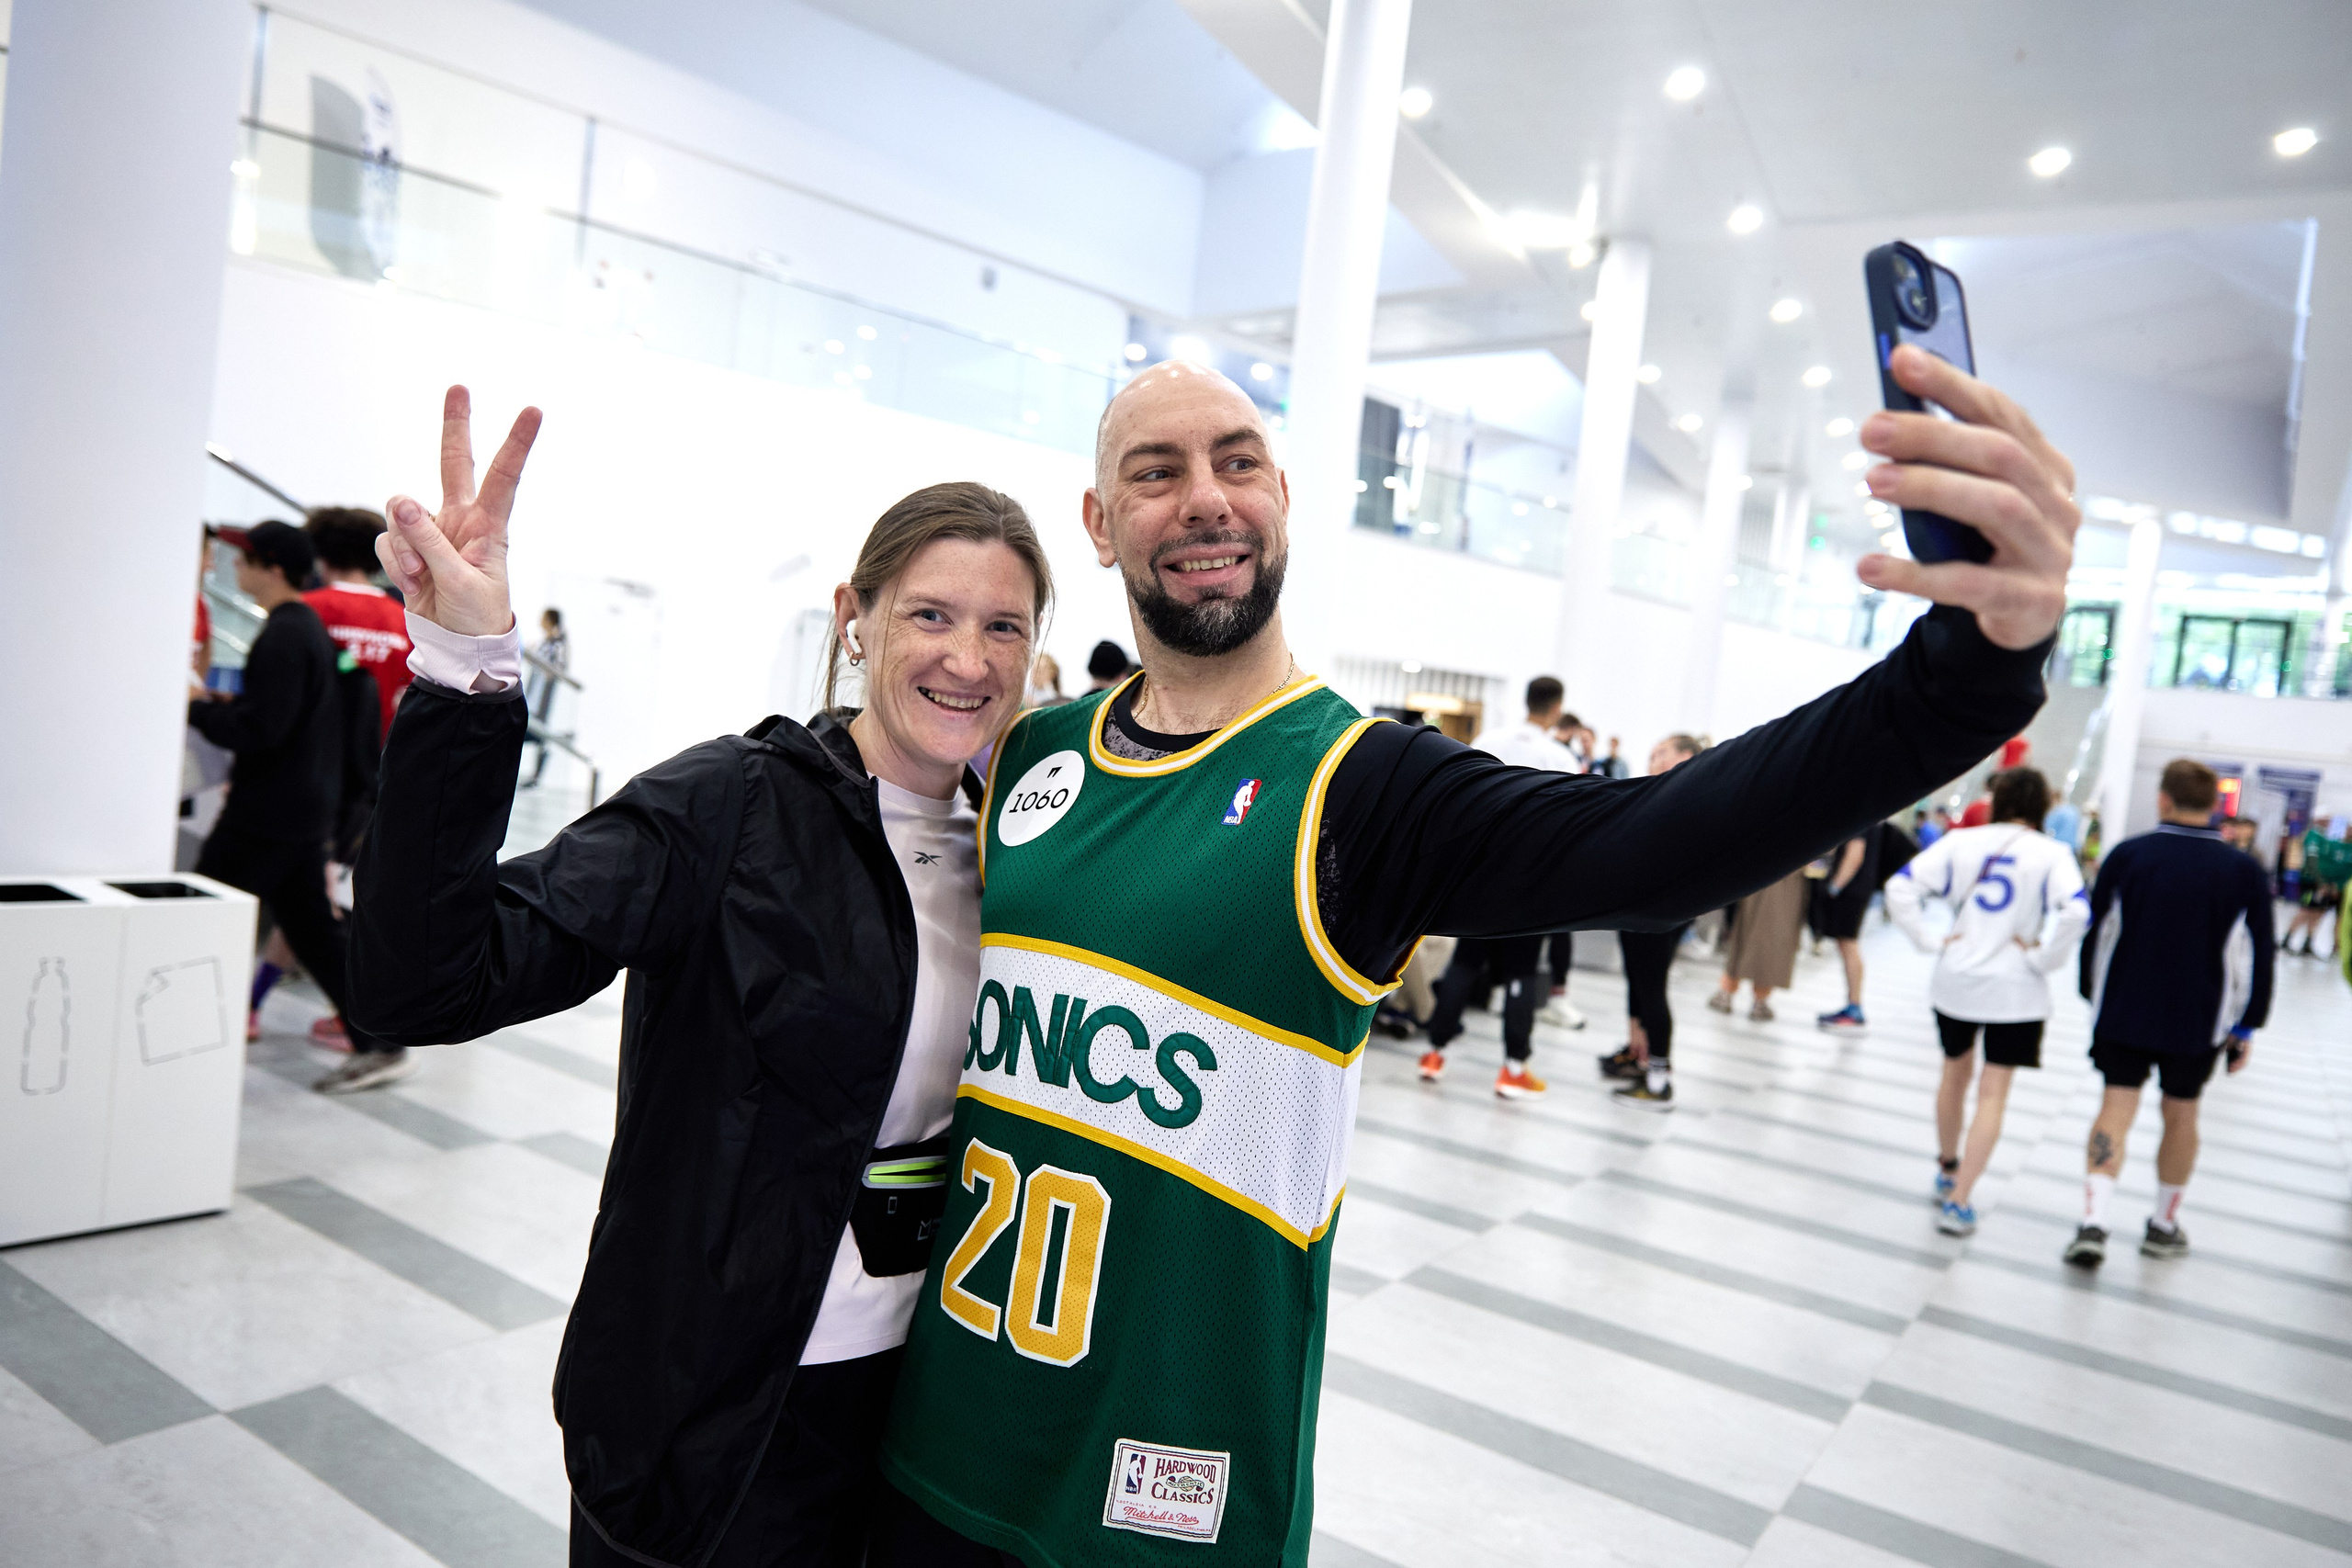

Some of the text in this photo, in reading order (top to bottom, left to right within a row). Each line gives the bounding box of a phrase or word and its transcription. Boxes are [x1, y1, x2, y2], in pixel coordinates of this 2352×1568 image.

[1008, 787, 1069, 813] 1060
[1974, 856, 2016, 912] 5
[941, 1137, 1112, 1368] 20
[1154, 1458, 1216, 1483] HARDWOOD
[1151, 1482, 1214, 1504] CLASSICS
[1123, 1506, 1169, 1520] Mitchell
[1176, 1513, 1199, 1523] Ness
